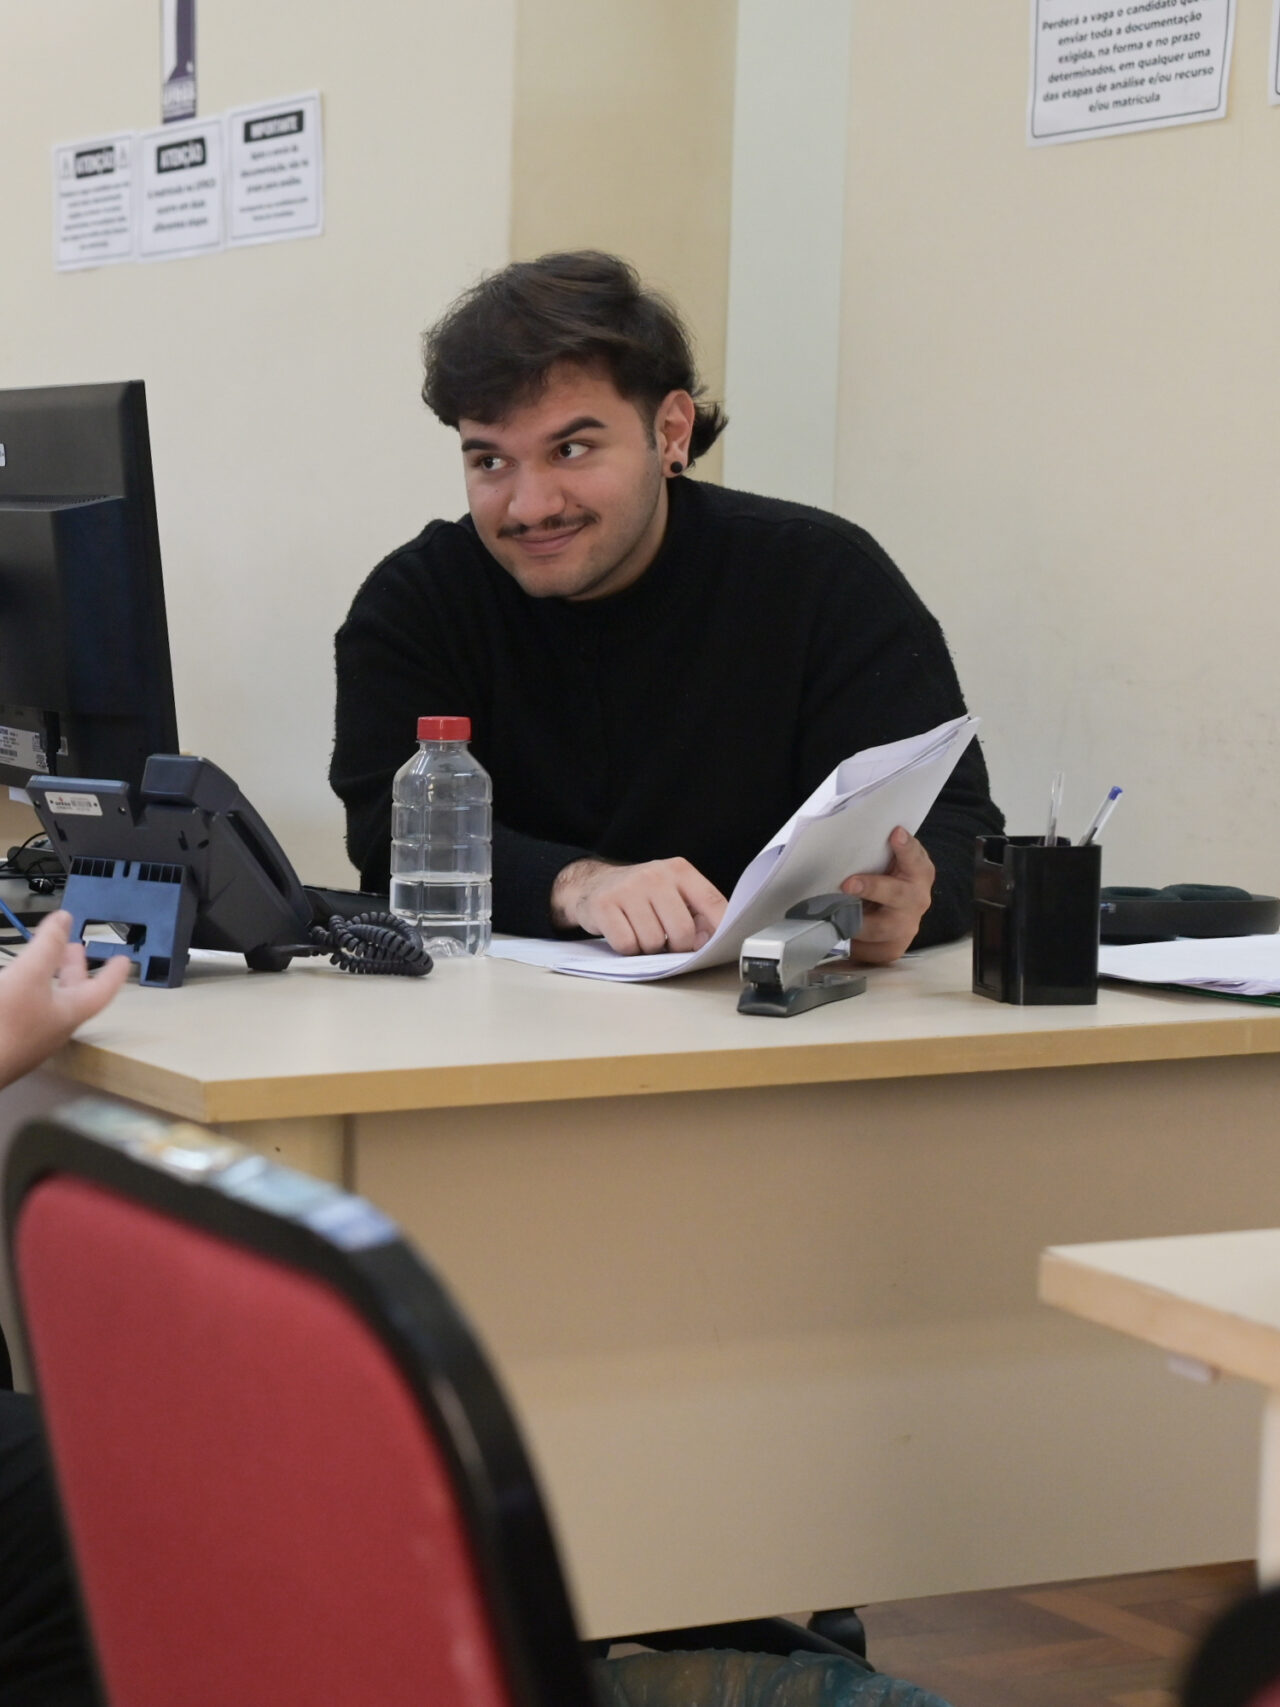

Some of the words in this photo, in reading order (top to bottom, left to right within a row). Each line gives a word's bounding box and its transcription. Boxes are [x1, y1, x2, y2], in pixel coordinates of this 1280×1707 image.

[1058, 31, 1087, 45] enviar
[1091, 27, 1112, 40] toda
[1116, 27, 1122, 35] a
[1125, 11, 1202, 34] documentação
[1082, 15, 1088, 23] a
[1091, 11, 1114, 22] vaga
[1117, 8, 1123, 17] o
[1126, 0, 1177, 15] candidato
[1058, 49, 1095, 63] exigida,
[1098, 48, 1109, 56] na
[1113, 41, 1143, 53] forma
[1146, 40, 1152, 48] e
[1155, 37, 1168, 46] no
[1171, 31, 1201, 45] prazo
[1048, 65, 1116, 83] determinados,
[1119, 61, 1135, 71] em
[1138, 53, 1184, 69] qualquer
[1188, 48, 1210, 60] uma
[1043, 92, 1059, 102] das
[1062, 86, 1093, 99] etapas
[1096, 83, 1107, 93] de
[1148, 72, 1172, 85] e/ou
[1175, 66, 1214, 80] recurso
[1089, 100, 1109, 112] e/ou
